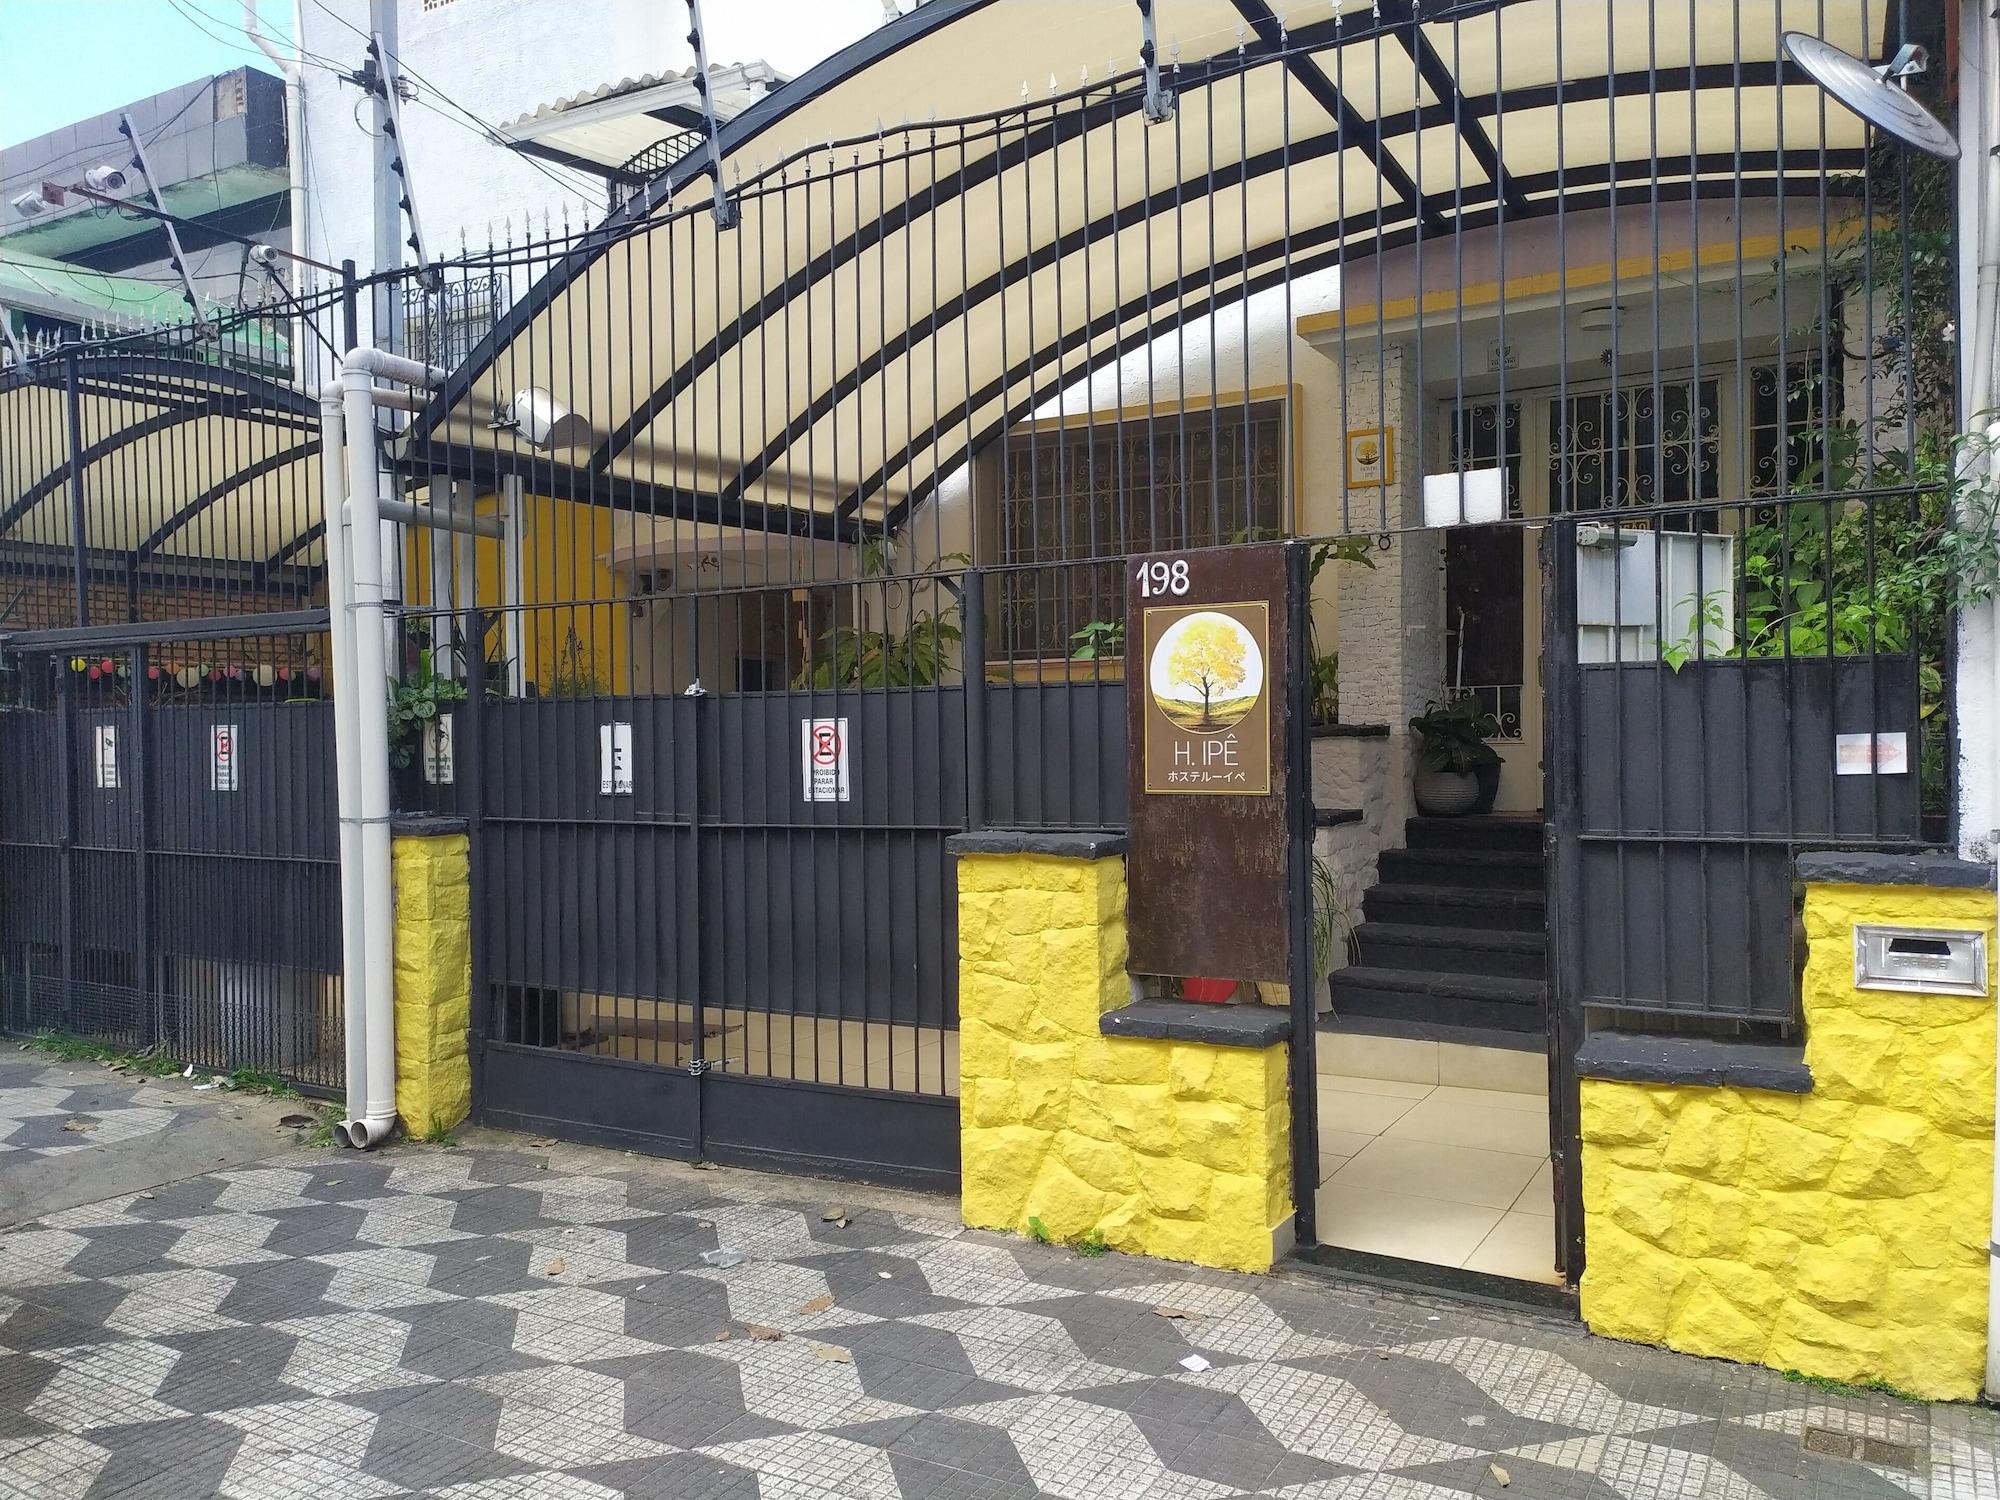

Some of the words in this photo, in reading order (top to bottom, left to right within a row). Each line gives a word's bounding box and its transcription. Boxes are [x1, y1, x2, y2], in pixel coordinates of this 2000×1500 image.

[1136, 559, 1190, 598] 198
[1174, 741, 1195, 766] H.
[1203, 733, 1239, 766] IPÊ
[813, 768, 840, 776] ROIBID
[1168, 770, 1246, 783] ホステルーイペ
[808, 786, 845, 794] ETACIONR
